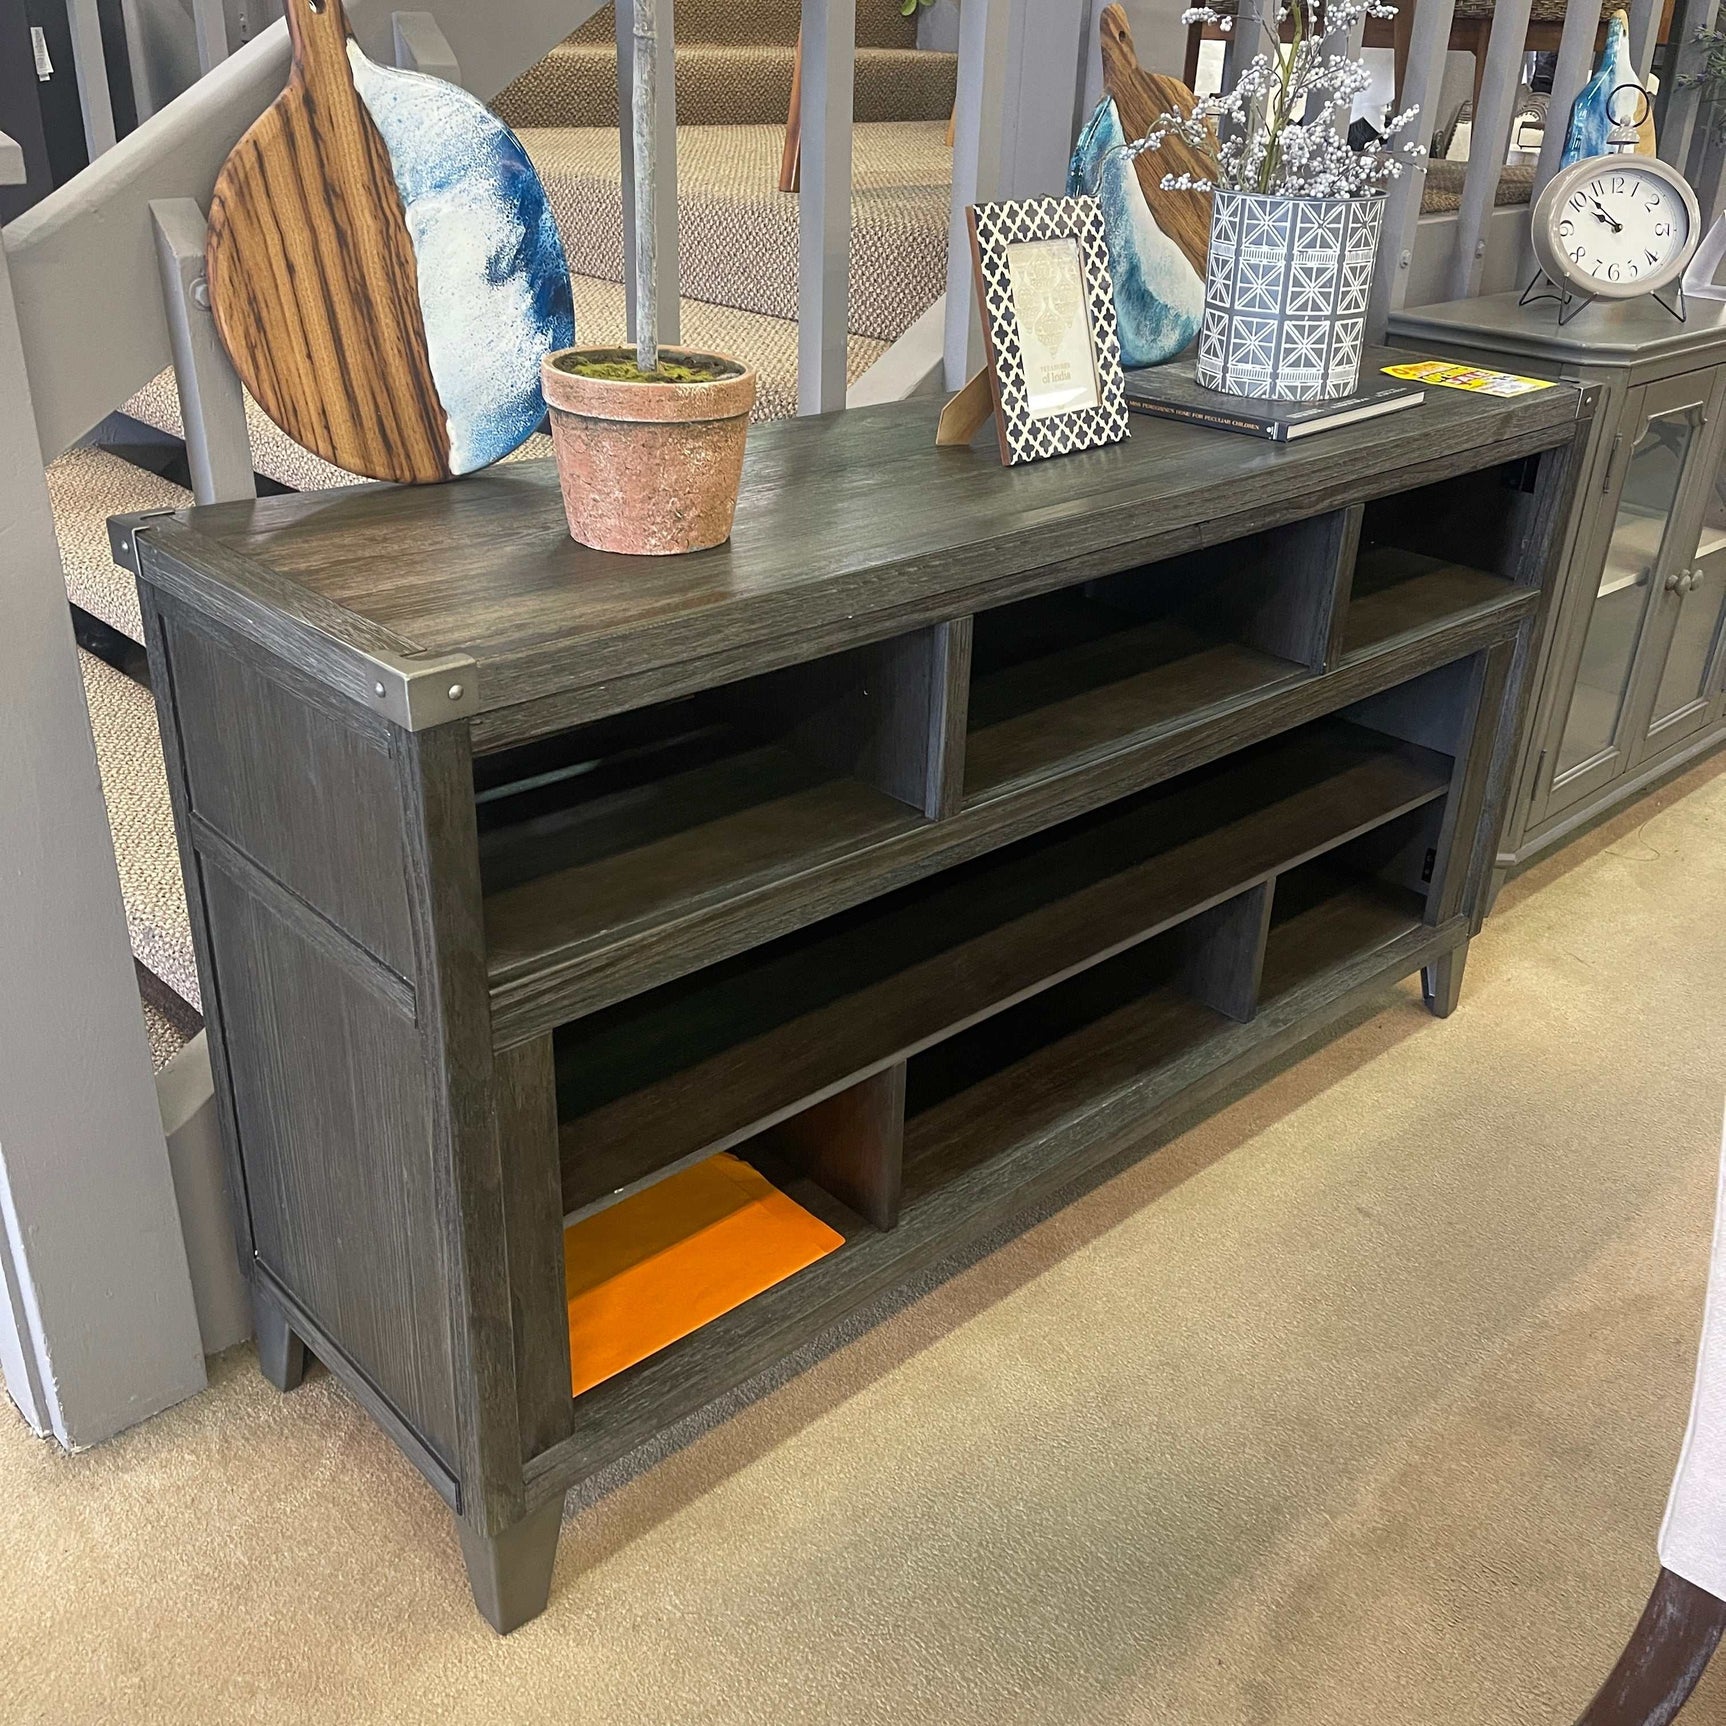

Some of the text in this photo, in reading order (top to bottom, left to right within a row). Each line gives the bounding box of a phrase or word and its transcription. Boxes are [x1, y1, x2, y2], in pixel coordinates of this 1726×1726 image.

[1591, 180, 1604, 197] 11
[1612, 177, 1625, 194] 12
[1631, 182, 1640, 197] 1
[1569, 191, 1587, 213] 10
[1644, 193, 1660, 213] 2
[1560, 220, 1574, 237] 9
[1654, 223, 1670, 237] 3
[1569, 246, 1586, 264] 8
[1644, 248, 1658, 265] 4
[1592, 259, 1603, 277] 7
[1607, 263, 1620, 281] 6
[1627, 259, 1638, 278] 5
[1042, 371, 1071, 384] of India
[1176, 409, 1191, 417] HOME
[1192, 411, 1204, 420] FOR
[1204, 415, 1231, 426] PECULIAR
[1231, 420, 1260, 431] CHILDREN
